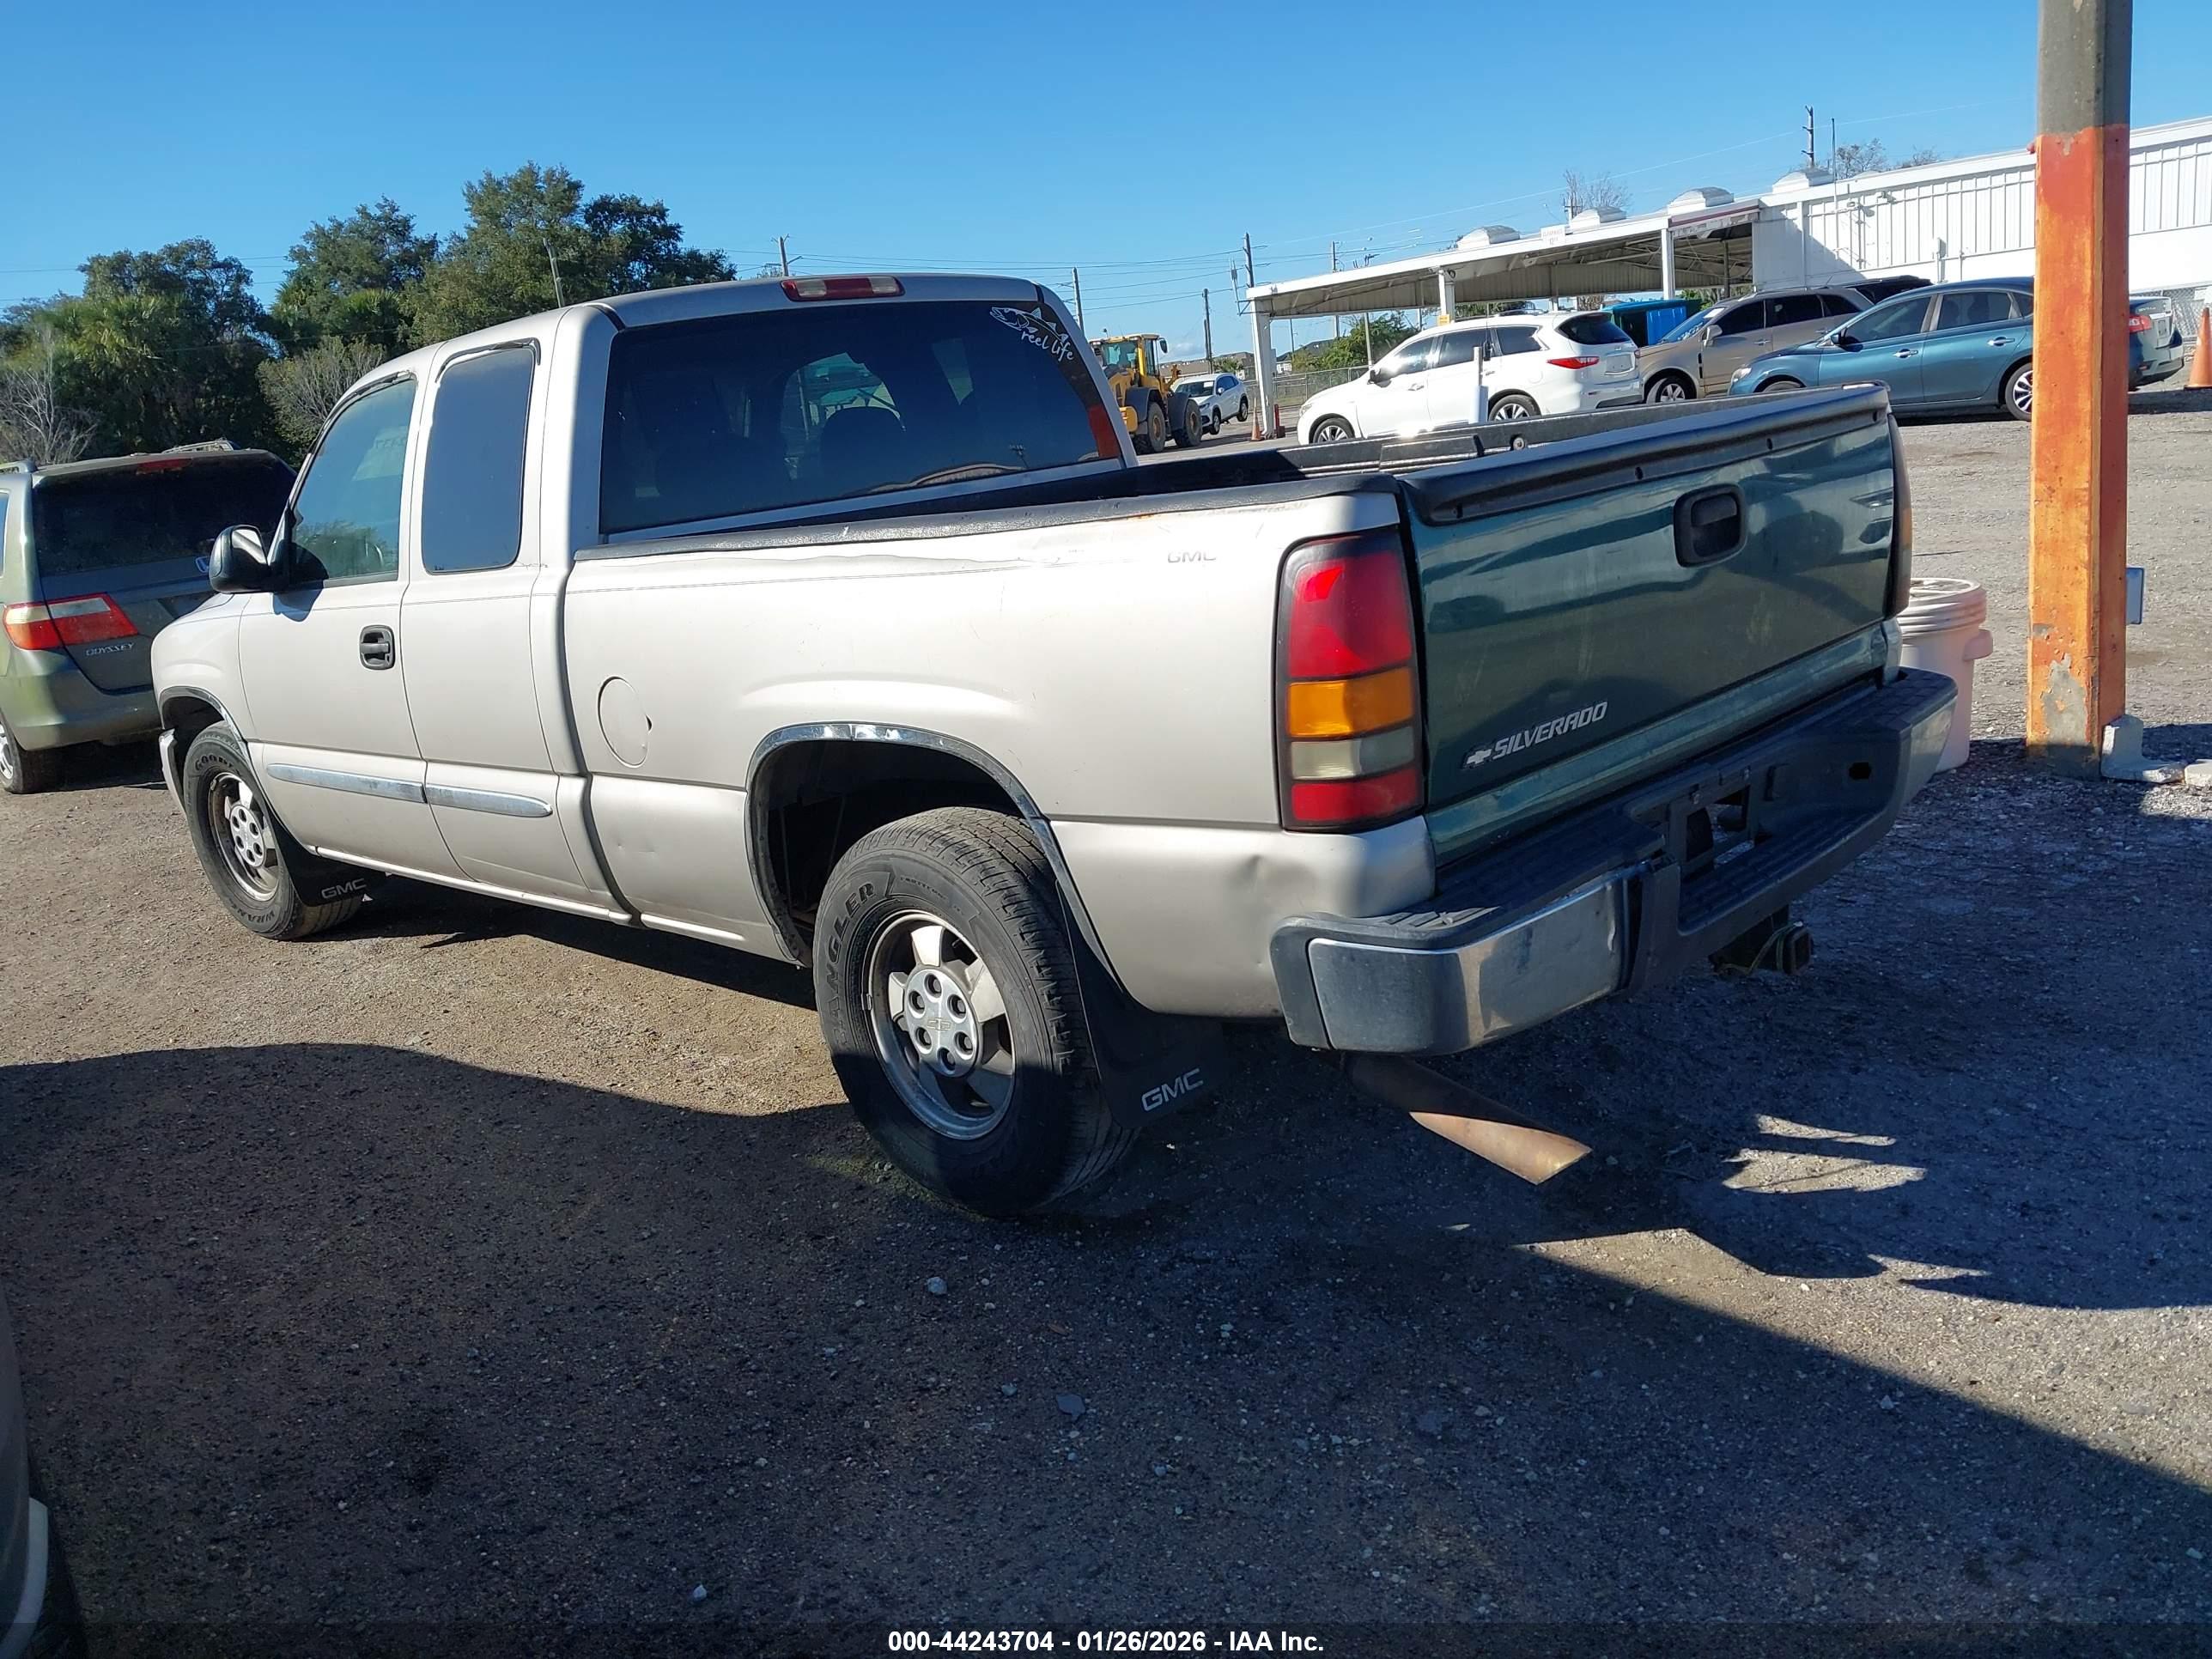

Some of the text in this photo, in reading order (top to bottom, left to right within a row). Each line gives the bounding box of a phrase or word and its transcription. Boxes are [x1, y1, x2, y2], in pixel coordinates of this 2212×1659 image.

[1021, 331, 1074, 362] reel life
[85, 642, 135, 656] ODYSSEY
[1492, 701, 1608, 760] SILVERADO
[321, 878, 367, 899] GMC
[1141, 1067, 1204, 1111] GMC
